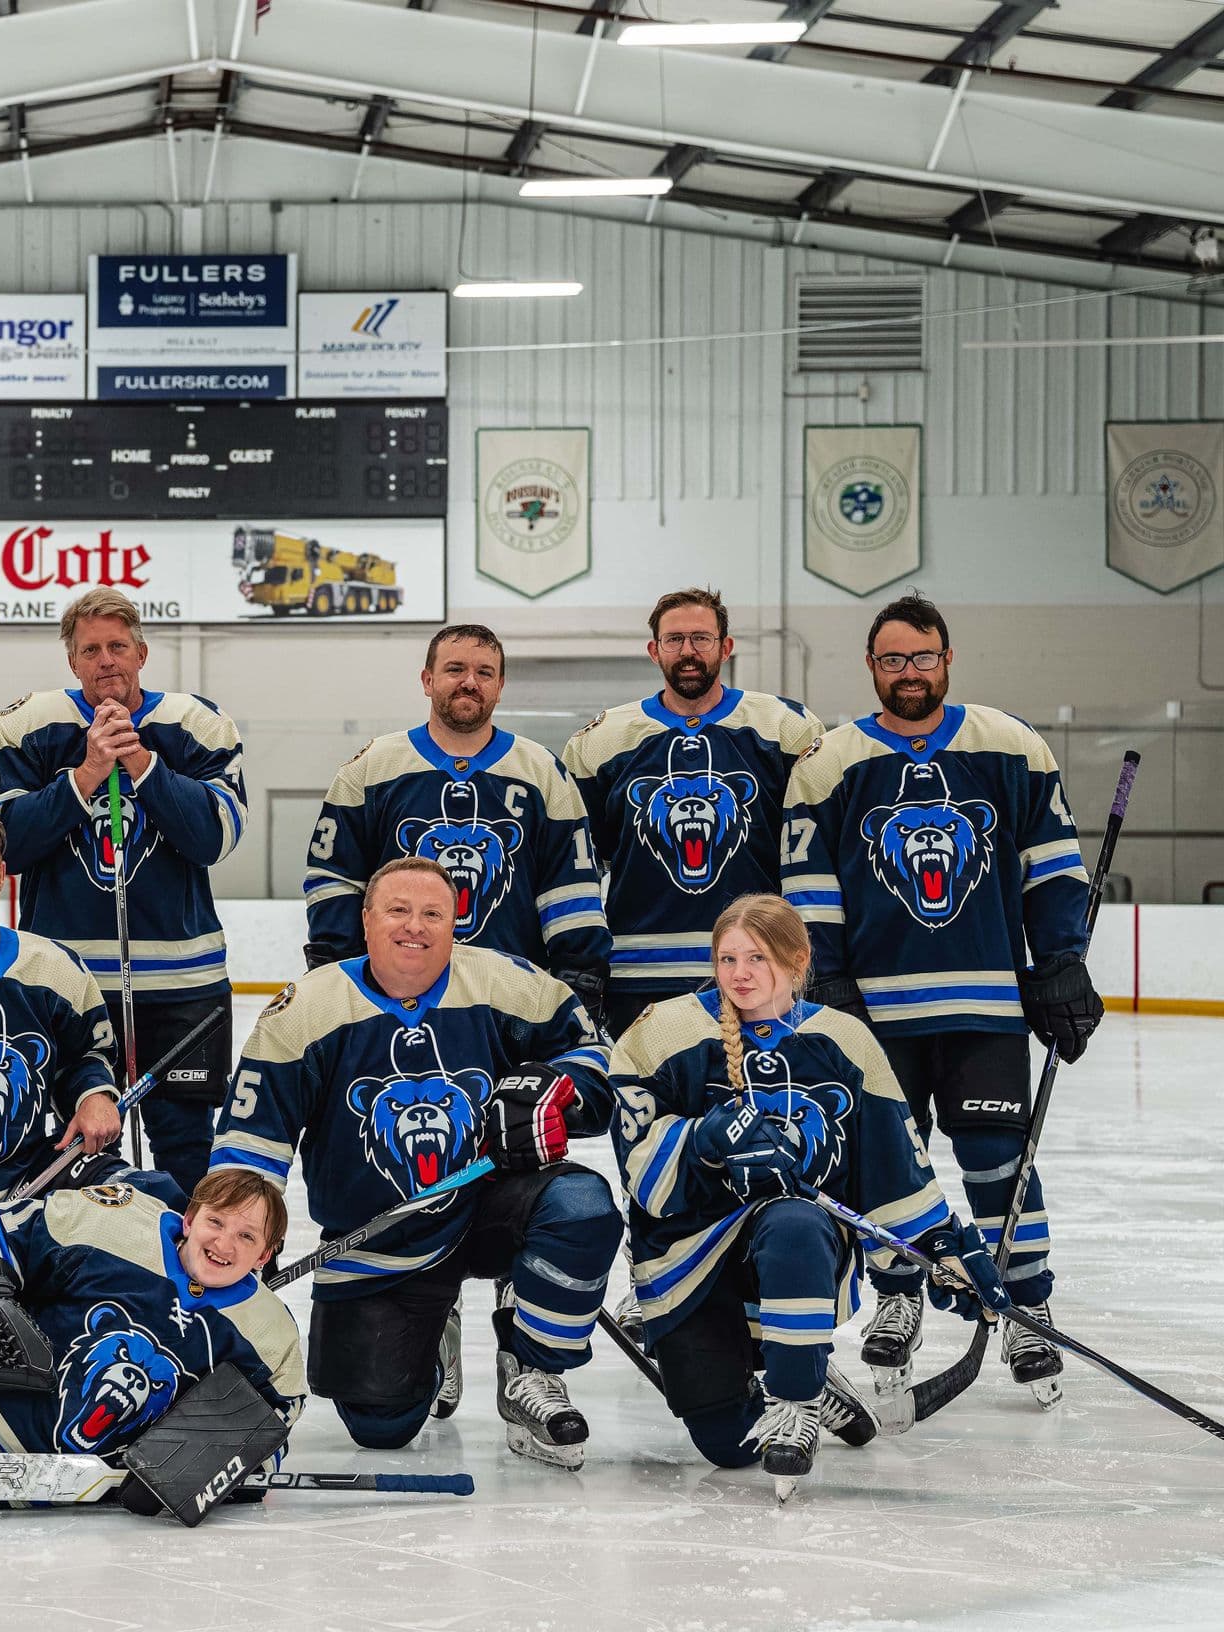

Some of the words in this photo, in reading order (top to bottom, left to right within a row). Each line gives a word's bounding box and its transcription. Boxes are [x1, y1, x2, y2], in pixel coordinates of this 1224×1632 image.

[119, 265, 266, 282] FULLERS
[198, 291, 267, 309] Sotheby's
[114, 374, 269, 390] FULLERSRE.COM
[31, 408, 73, 418] PENALTY
[295, 408, 336, 418] PLAYER
[385, 408, 427, 418] PENALTY
[111, 449, 151, 463] HOME
[170, 454, 210, 465] PERIOD
[229, 450, 274, 463] GUEST
[168, 487, 210, 498] PENALTY
[1, 526, 152, 591] Cote
[504, 784, 527, 818] C
[1049, 782, 1077, 826] 4
[309, 817, 337, 861] 3
[572, 828, 598, 871] 1
[167, 1069, 209, 1081] CCM
[230, 1070, 262, 1120] 5
[962, 1099, 1022, 1114] CCM
[196, 1456, 246, 1514] CCM
